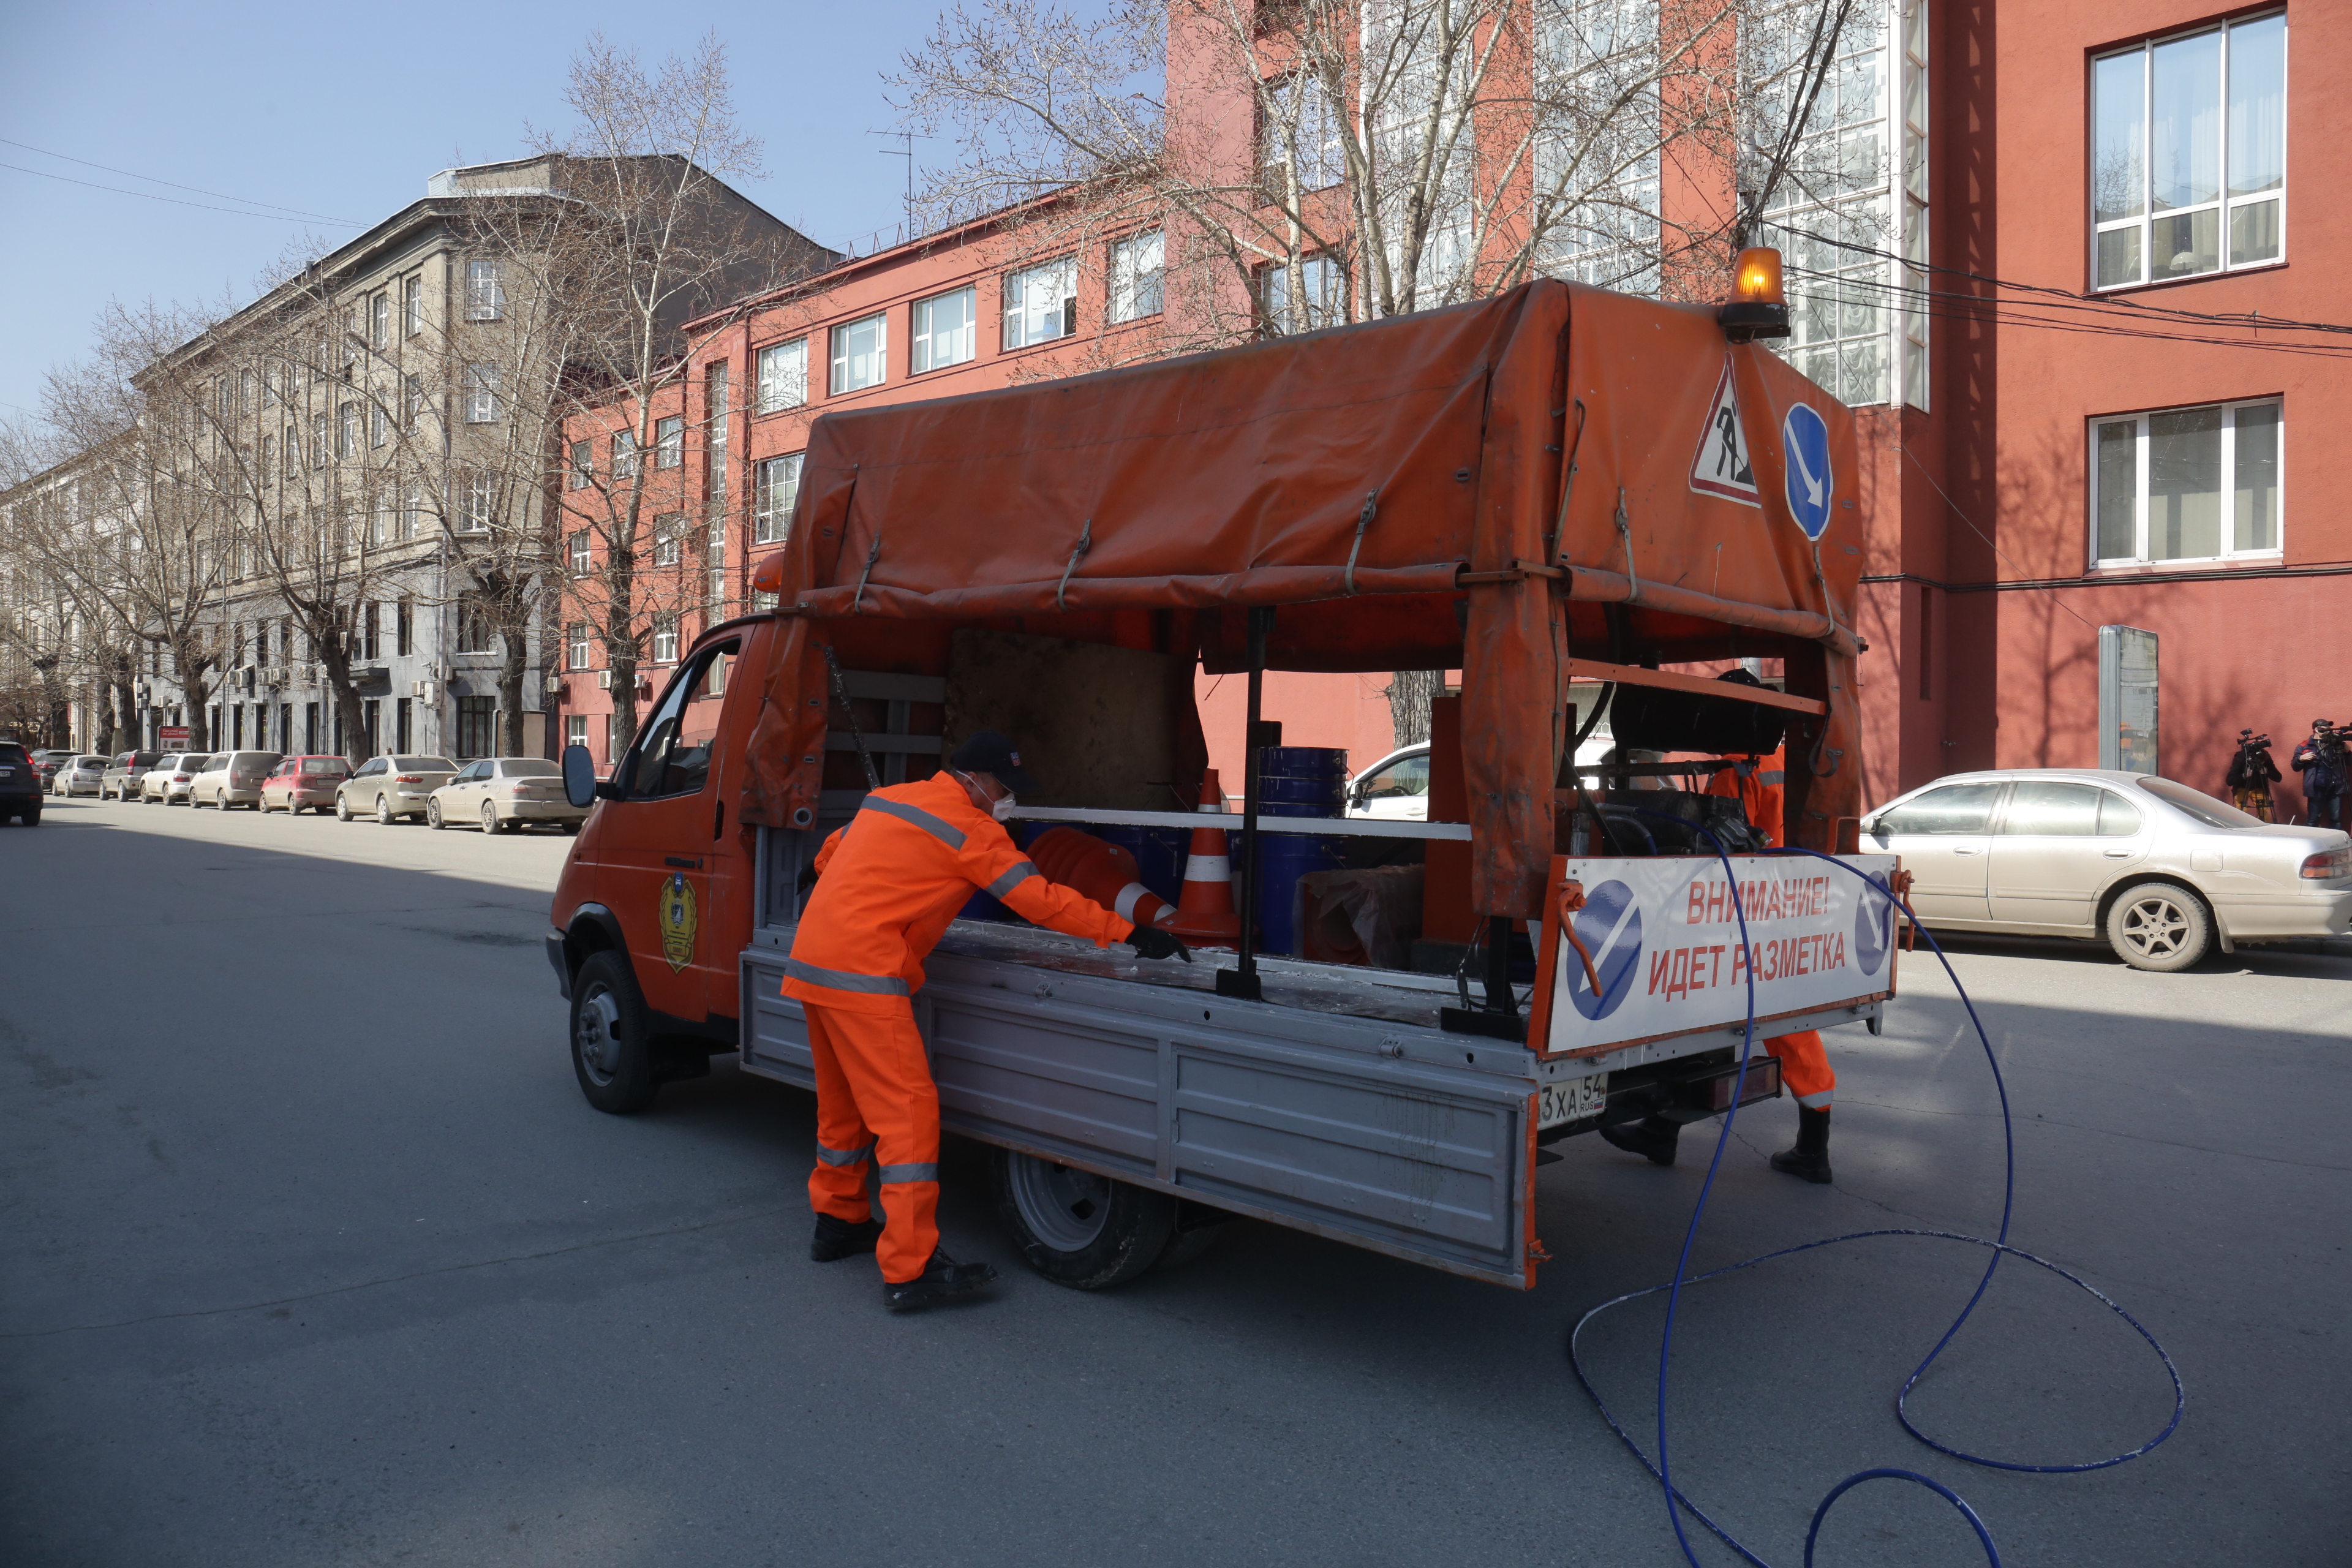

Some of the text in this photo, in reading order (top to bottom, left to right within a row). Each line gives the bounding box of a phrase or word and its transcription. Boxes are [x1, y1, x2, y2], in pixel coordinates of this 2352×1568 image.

[1686, 876, 1830, 925] ВНИМАНИЕ!
[1648, 931, 1846, 1003] ИДЕТ РАЗМЕТКА
[1538, 1085, 1577, 1123] 3ХА
[1580, 1101, 1594, 1112] RUS
[1583, 1074, 1601, 1101] 54
